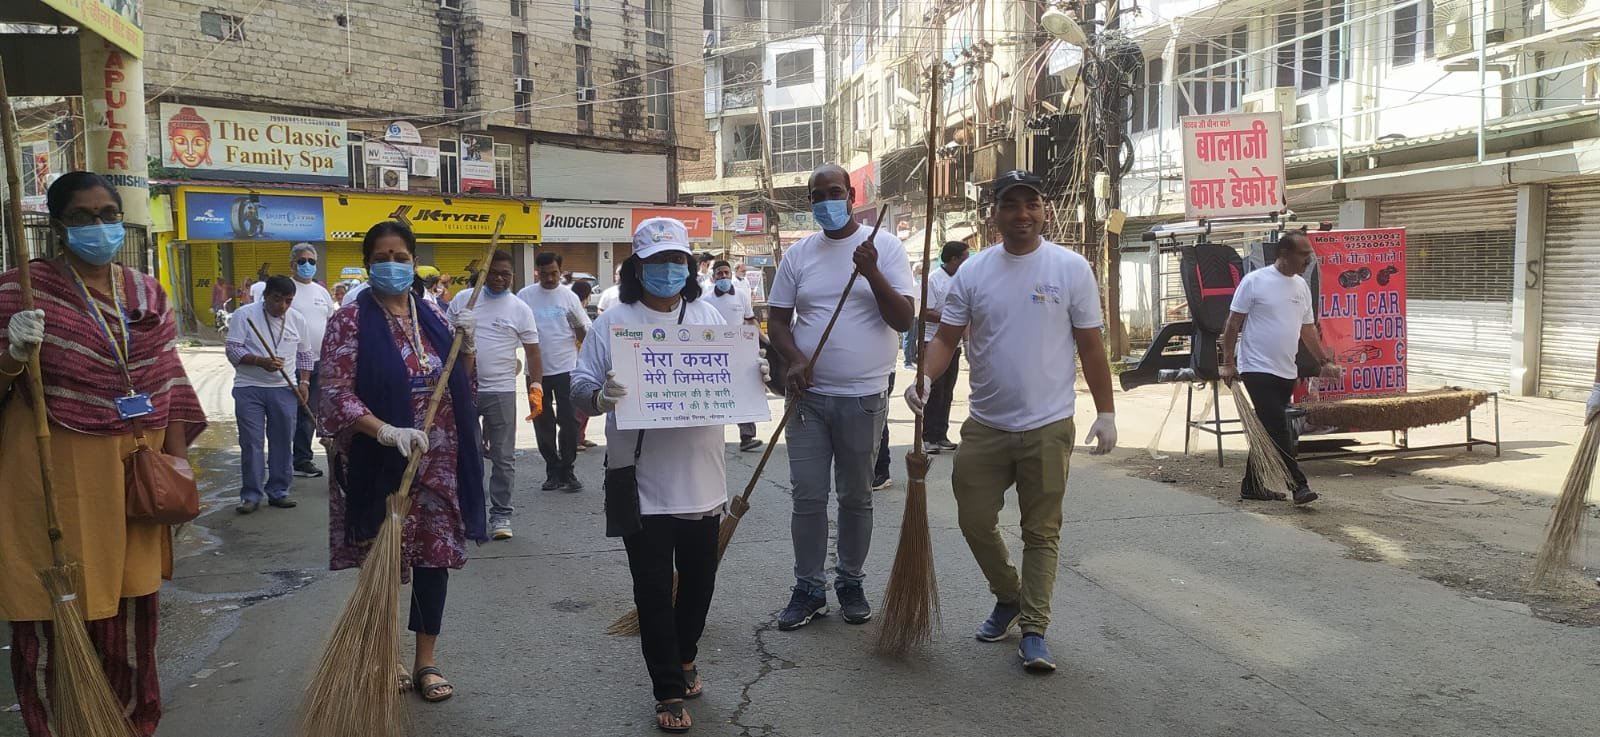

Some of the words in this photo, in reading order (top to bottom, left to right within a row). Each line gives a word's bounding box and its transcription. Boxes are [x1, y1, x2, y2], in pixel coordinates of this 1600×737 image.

[104, 40, 128, 170] APULAR
[213, 119, 259, 142] The
[266, 124, 341, 149] Classic
[1195, 119, 1268, 161] बालाजी
[226, 145, 294, 171] Family
[300, 150, 334, 172] Spa
[1189, 178, 1225, 209] कार
[1227, 166, 1278, 208] डेकोर
[544, 214, 625, 229] BRIDGESTONE
[1320, 294, 1357, 317] LAJI
[1367, 292, 1399, 315] CAR
[1354, 316, 1404, 340] DECOR
[641, 347, 673, 367] मेरा
[680, 353, 729, 367] कचरा
[643, 369, 666, 384] मेरी
[672, 369, 731, 384] जिम्मेदारी
[1352, 365, 1405, 390] COVER
[645, 390, 658, 399] अब
[662, 388, 687, 399] भोपाल
[690, 388, 702, 398] की
[705, 388, 711, 398] है
[679, 402, 685, 410] 1
[689, 401, 700, 410] की
[704, 401, 710, 410] है
